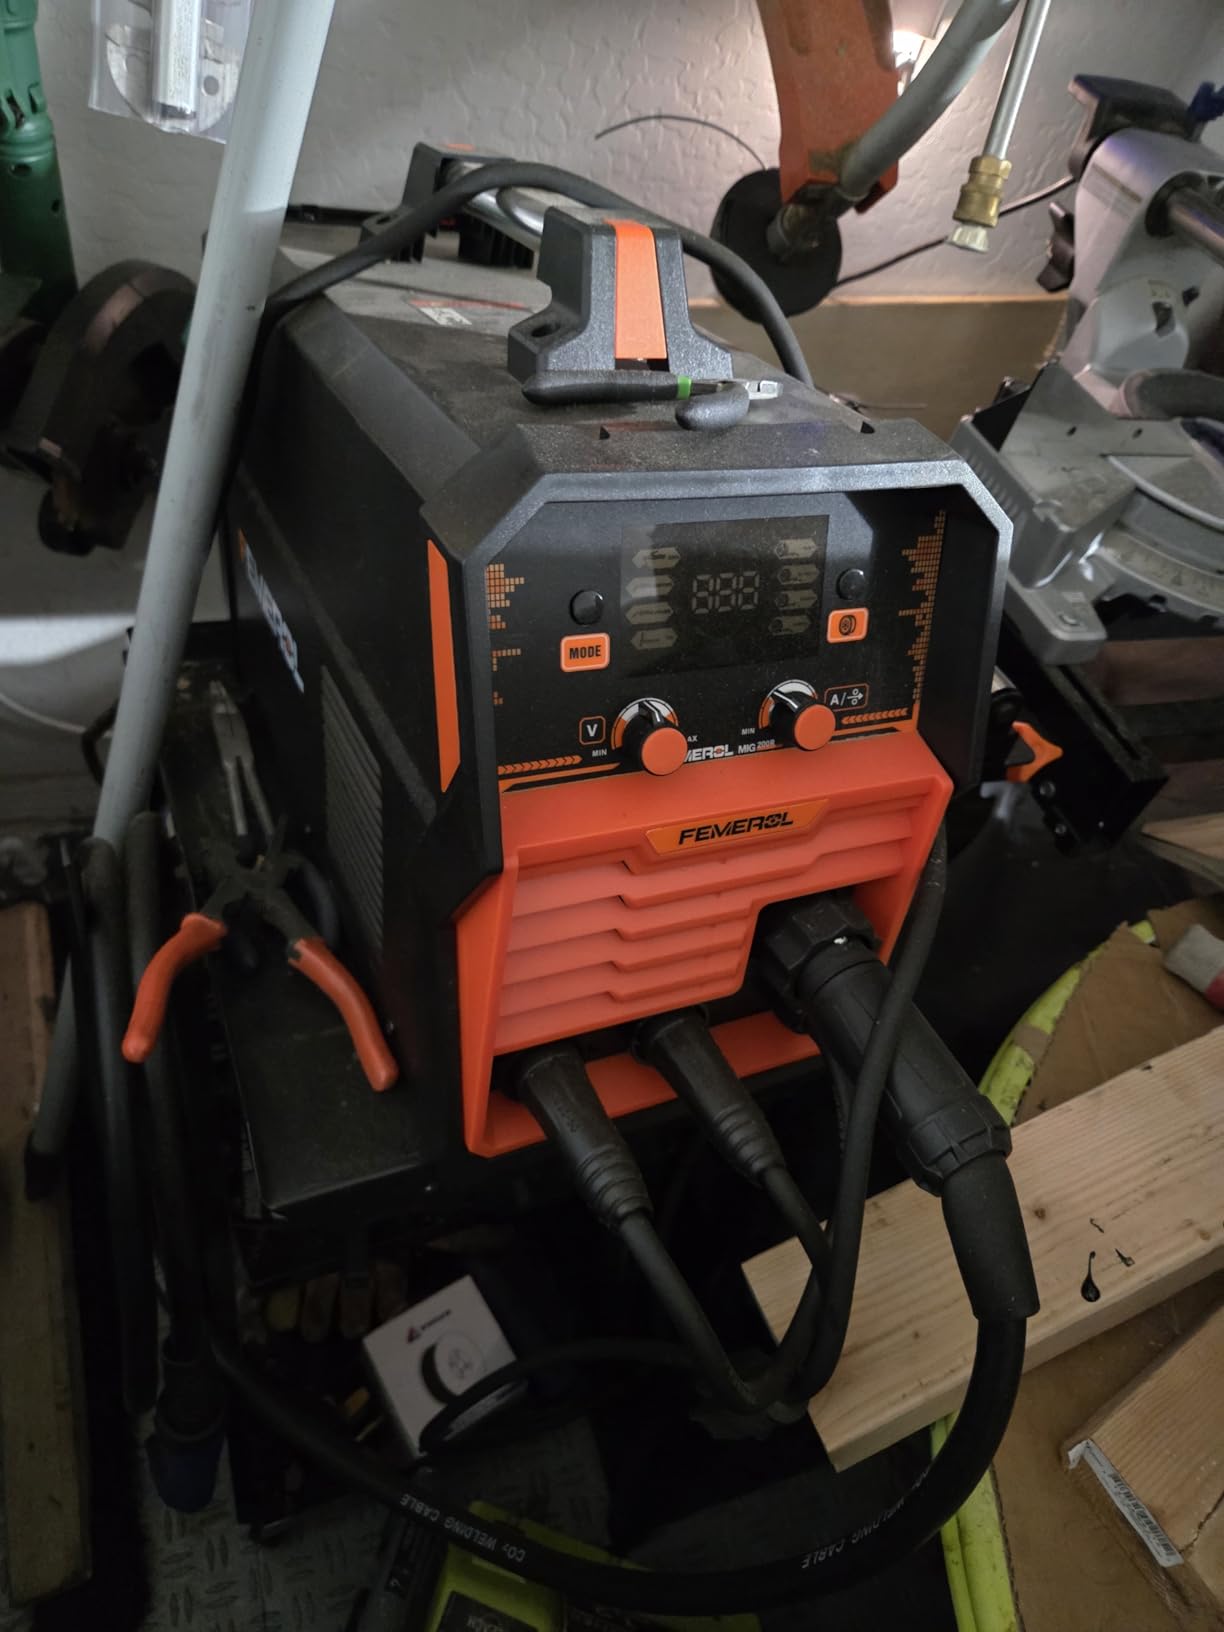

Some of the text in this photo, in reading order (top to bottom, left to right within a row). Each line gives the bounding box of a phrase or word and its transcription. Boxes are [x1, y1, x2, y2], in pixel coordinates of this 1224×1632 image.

[569, 645, 602, 660] MODE
[586, 723, 598, 737] V
[741, 728, 755, 736] MIN
[687, 735, 698, 743] AX
[592, 748, 607, 757] MIN
[738, 743, 756, 754] MIG
[679, 811, 794, 845] FEMEROL
[399, 1493, 441, 1521] CABLE
[443, 1517, 498, 1551] WELDING
